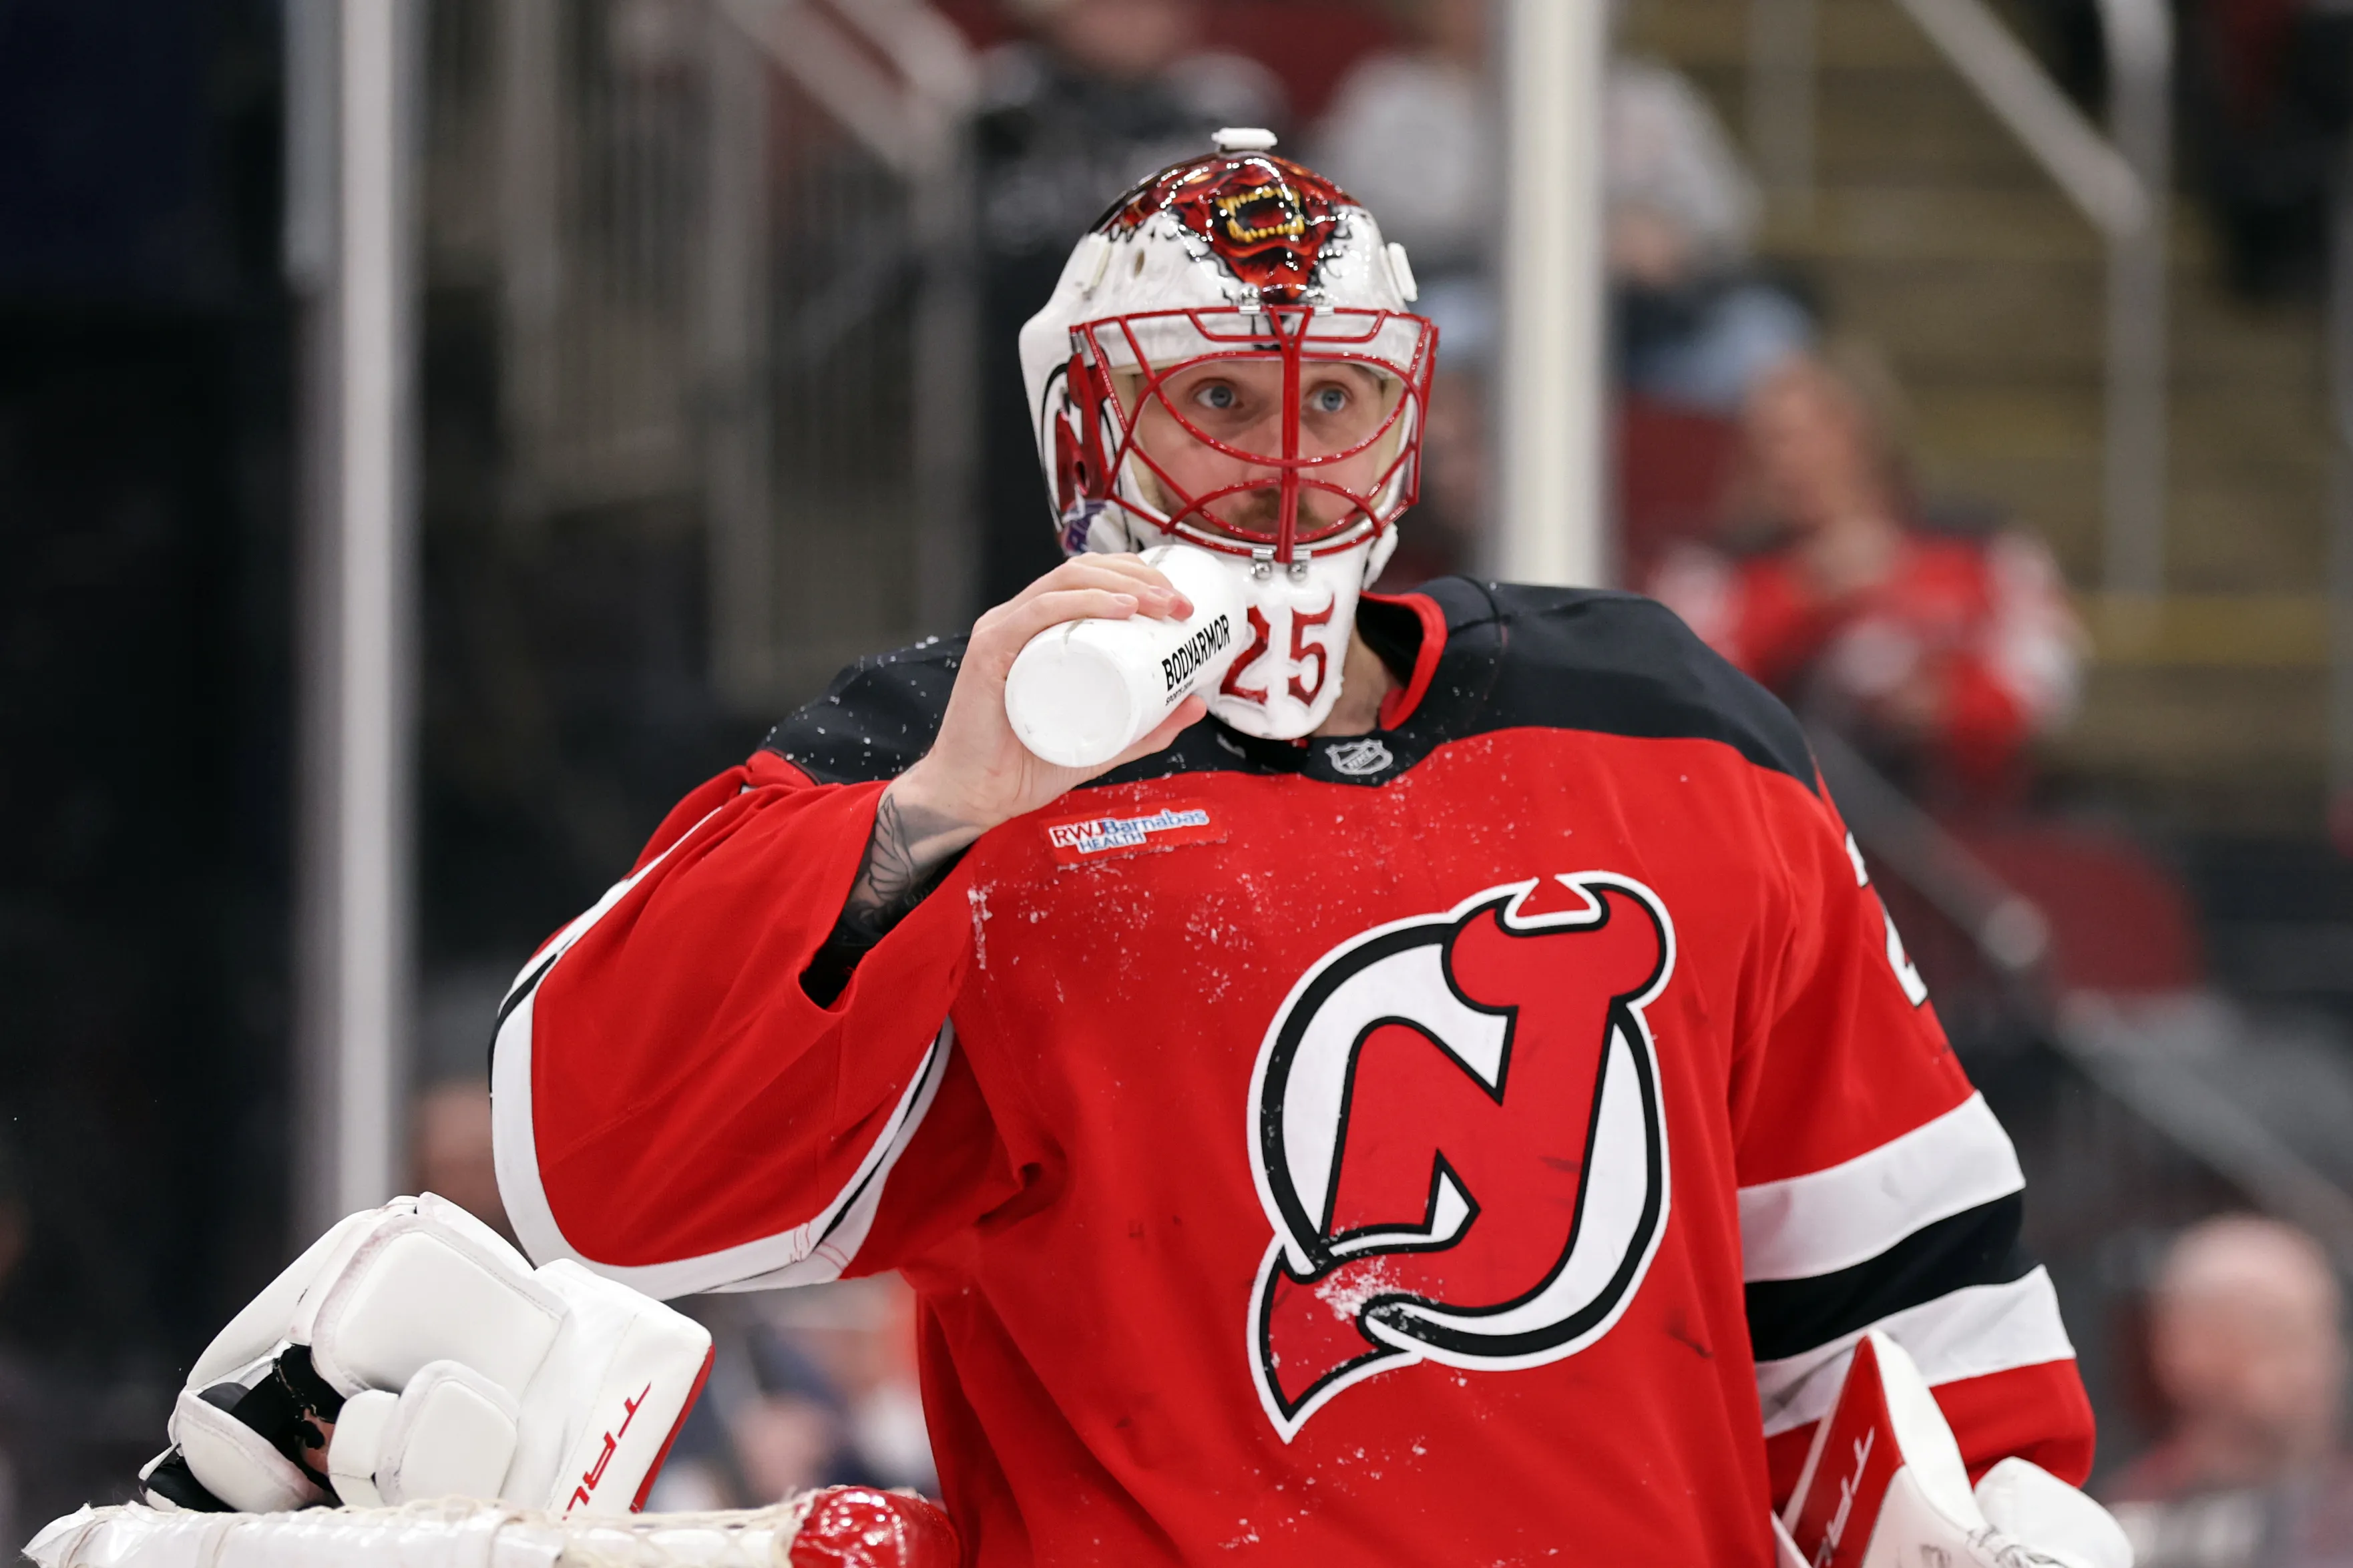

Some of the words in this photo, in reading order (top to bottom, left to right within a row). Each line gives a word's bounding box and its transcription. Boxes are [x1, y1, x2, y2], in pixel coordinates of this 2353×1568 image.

[1162, 614, 1231, 692] BODYARMOR
[1220, 591, 1335, 708] 25
[1079, 831, 1145, 852] HEALTH
